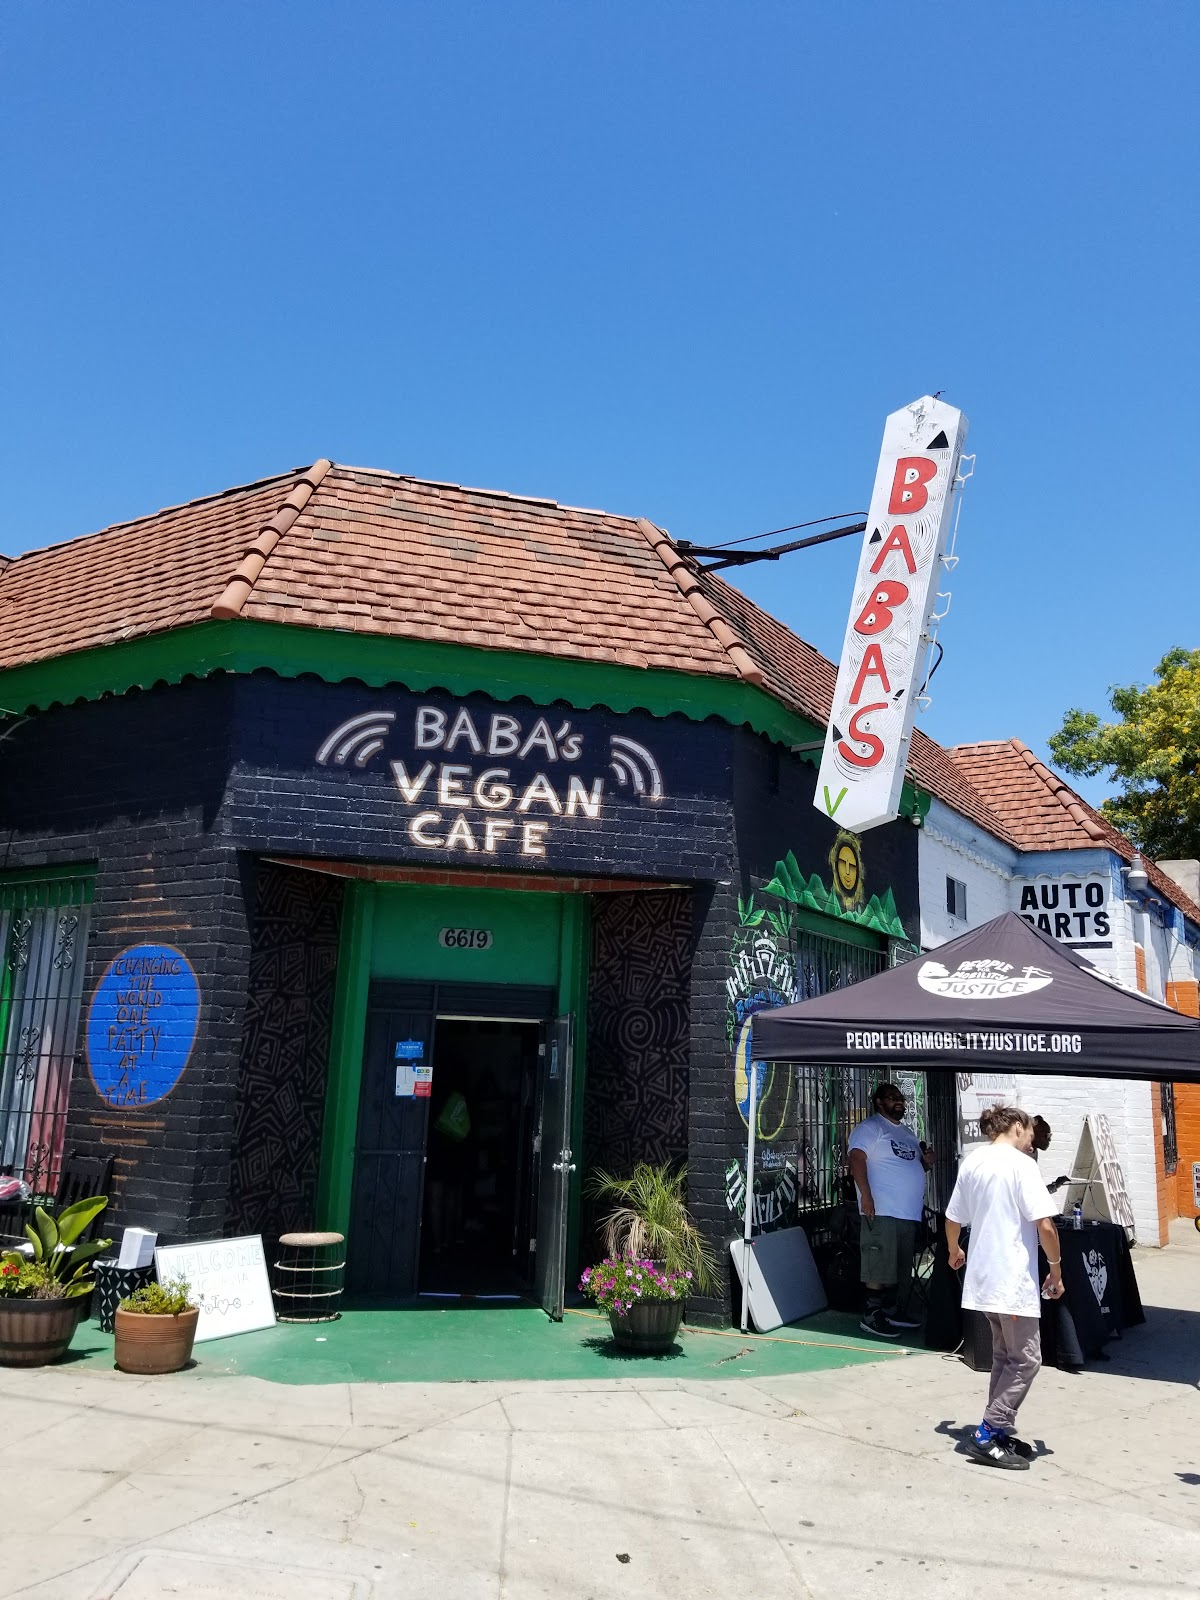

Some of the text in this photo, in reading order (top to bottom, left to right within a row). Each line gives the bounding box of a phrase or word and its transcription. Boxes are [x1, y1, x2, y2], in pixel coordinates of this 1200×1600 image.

[415, 706, 584, 762] BABA's
[390, 760, 605, 819] VEGAN
[408, 811, 549, 856] CAFE
[1020, 883, 1104, 910] AUTO
[444, 929, 490, 948] 6619
[957, 959, 1014, 972] PEOPLE
[129, 976, 155, 991] THE
[937, 981, 1028, 996] JUSTICE
[117, 991, 163, 1009] WORLD
[117, 1007, 150, 1025] ONE
[108, 1025, 161, 1061] PATTY
[847, 1032, 1082, 1053] PEOPLEFORMOBILITYJUSTICE.ORG
[119, 1055, 139, 1071] AT
[118, 1072, 129, 1088] A
[164, 1245, 262, 1279] WELCOME
[989, 1447, 1004, 1459] N
